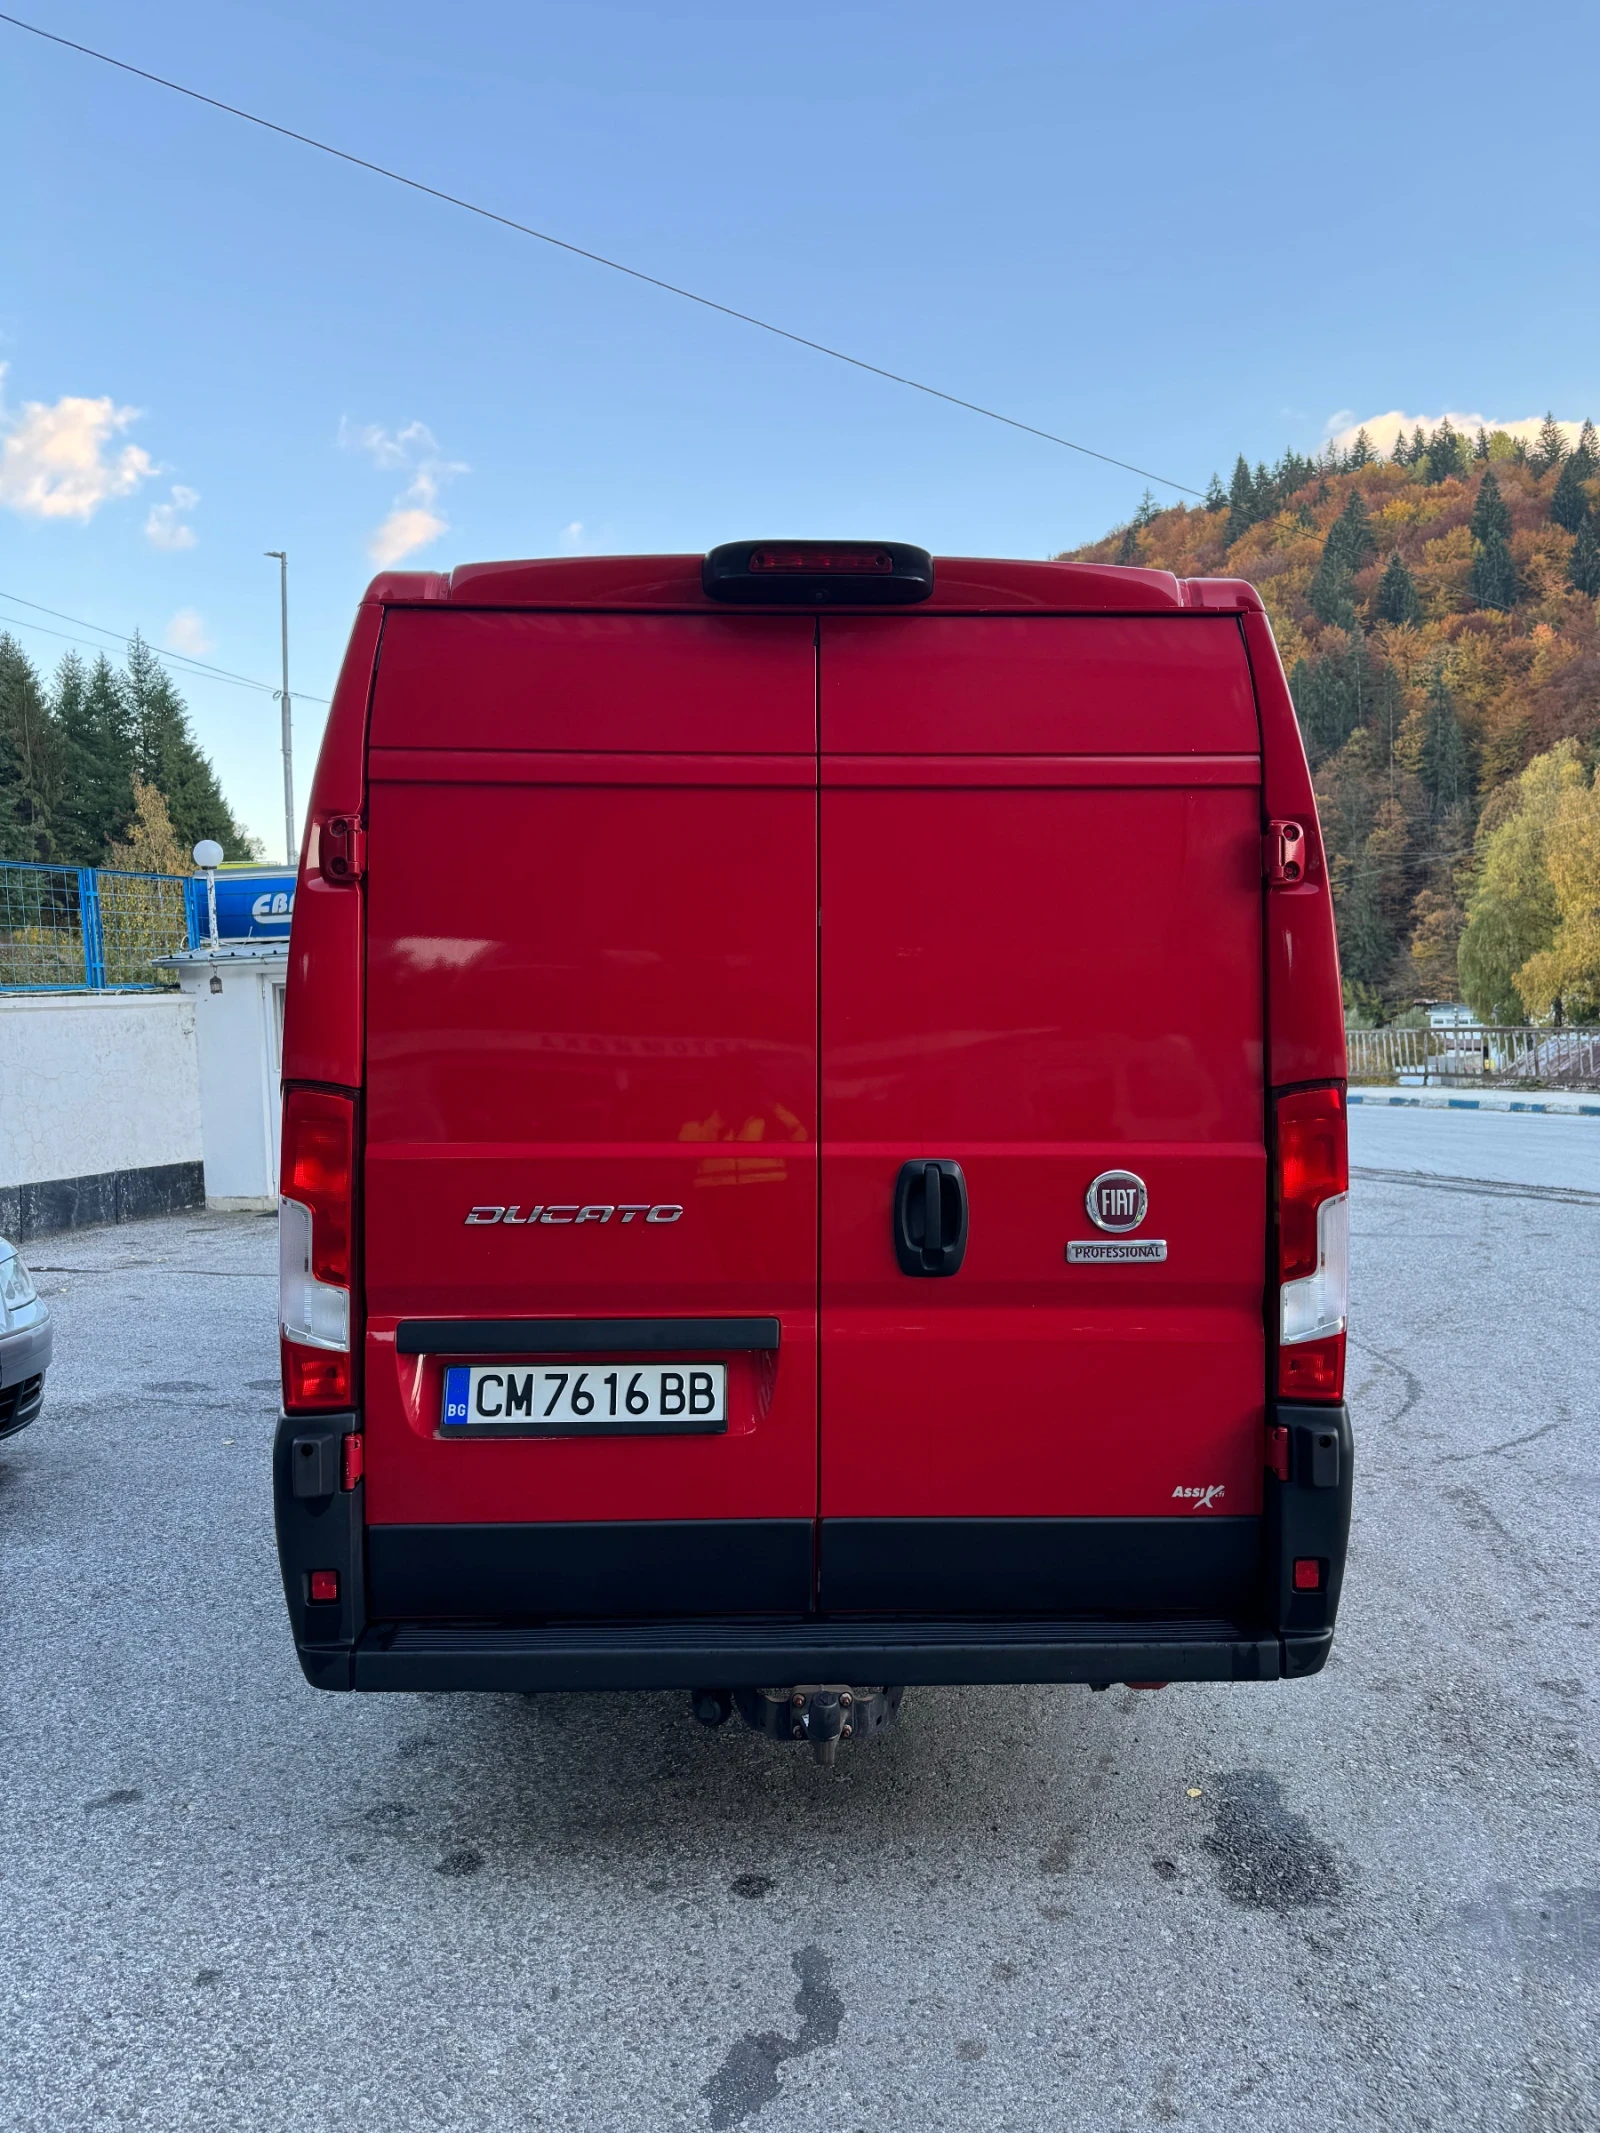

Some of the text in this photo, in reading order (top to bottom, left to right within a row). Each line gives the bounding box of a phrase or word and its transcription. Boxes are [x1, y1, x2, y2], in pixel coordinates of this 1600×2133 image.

[1101, 1188, 1137, 1216] FIAT
[464, 1204, 684, 1225] DUCATO
[1074, 1245, 1161, 1259] PROFESSIONAL
[447, 1403, 467, 1417] BG
